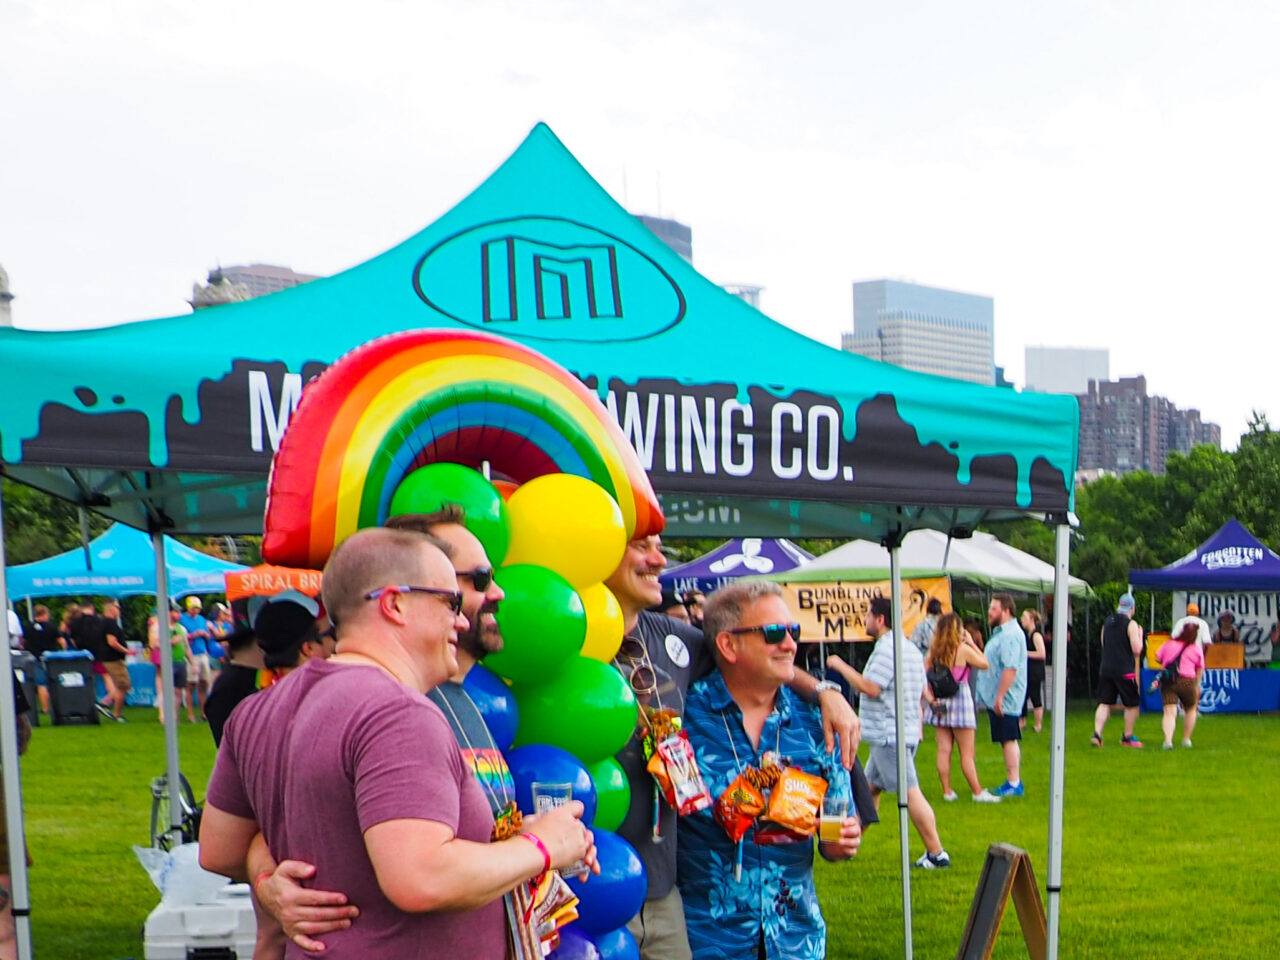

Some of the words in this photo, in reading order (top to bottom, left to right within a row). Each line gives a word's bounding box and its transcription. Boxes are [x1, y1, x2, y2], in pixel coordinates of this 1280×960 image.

[771, 402, 854, 481] CO.
[1201, 546, 1263, 565] FORGOTTEN
[241, 573, 296, 591] SPIRAL
[798, 586, 884, 609] BUMBLING
[816, 600, 868, 622] FOOLS
[825, 614, 868, 643] MEA
